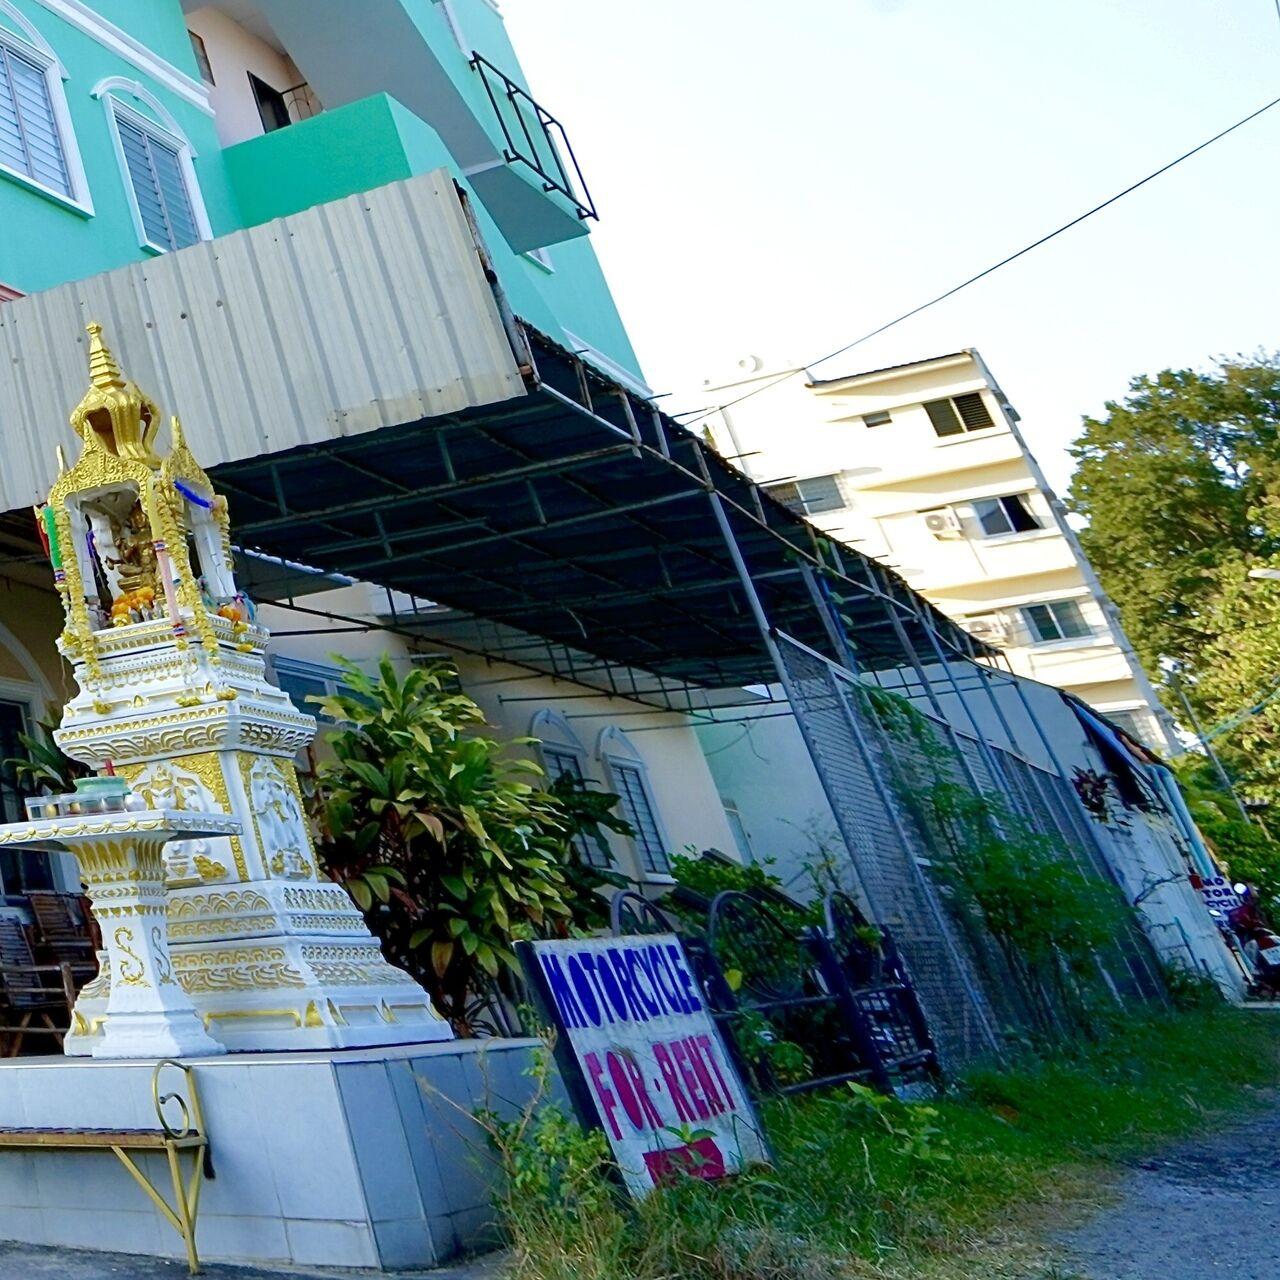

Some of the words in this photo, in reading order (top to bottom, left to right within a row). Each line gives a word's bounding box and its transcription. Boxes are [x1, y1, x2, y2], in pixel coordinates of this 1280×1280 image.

[540, 944, 702, 1029] MOTORCYCLE
[584, 1050, 665, 1141] FOR
[651, 1035, 737, 1123] RENT
